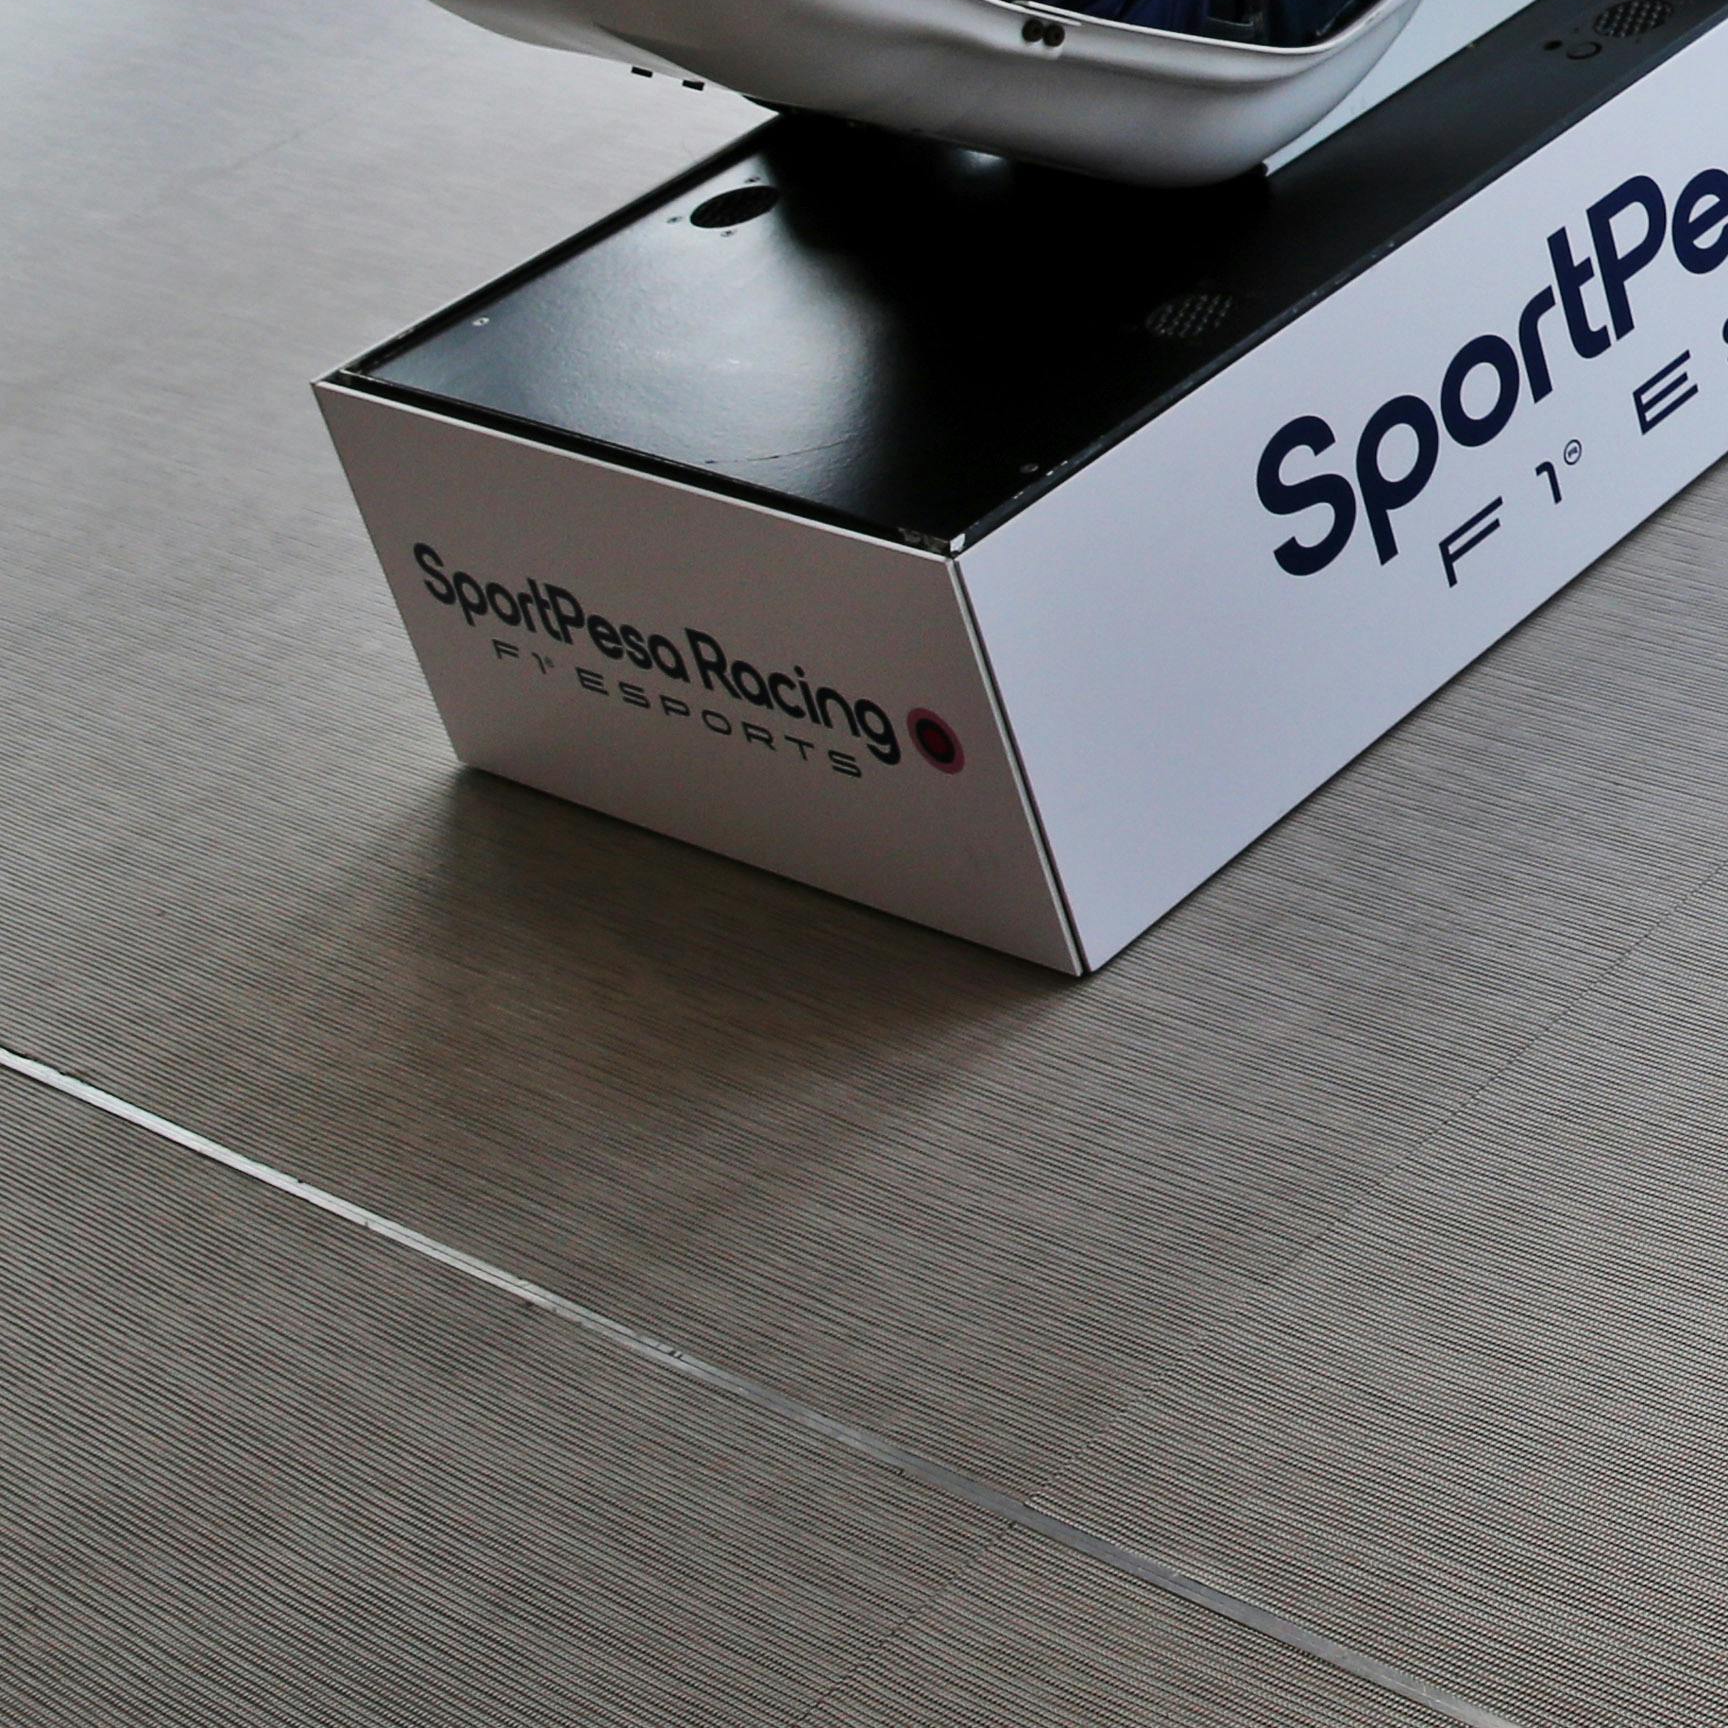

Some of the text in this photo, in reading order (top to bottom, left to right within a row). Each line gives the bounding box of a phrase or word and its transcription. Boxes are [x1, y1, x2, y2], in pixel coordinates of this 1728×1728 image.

[413, 543, 902, 767] SportPesa Racing
[575, 666, 864, 779] ESPORTS
